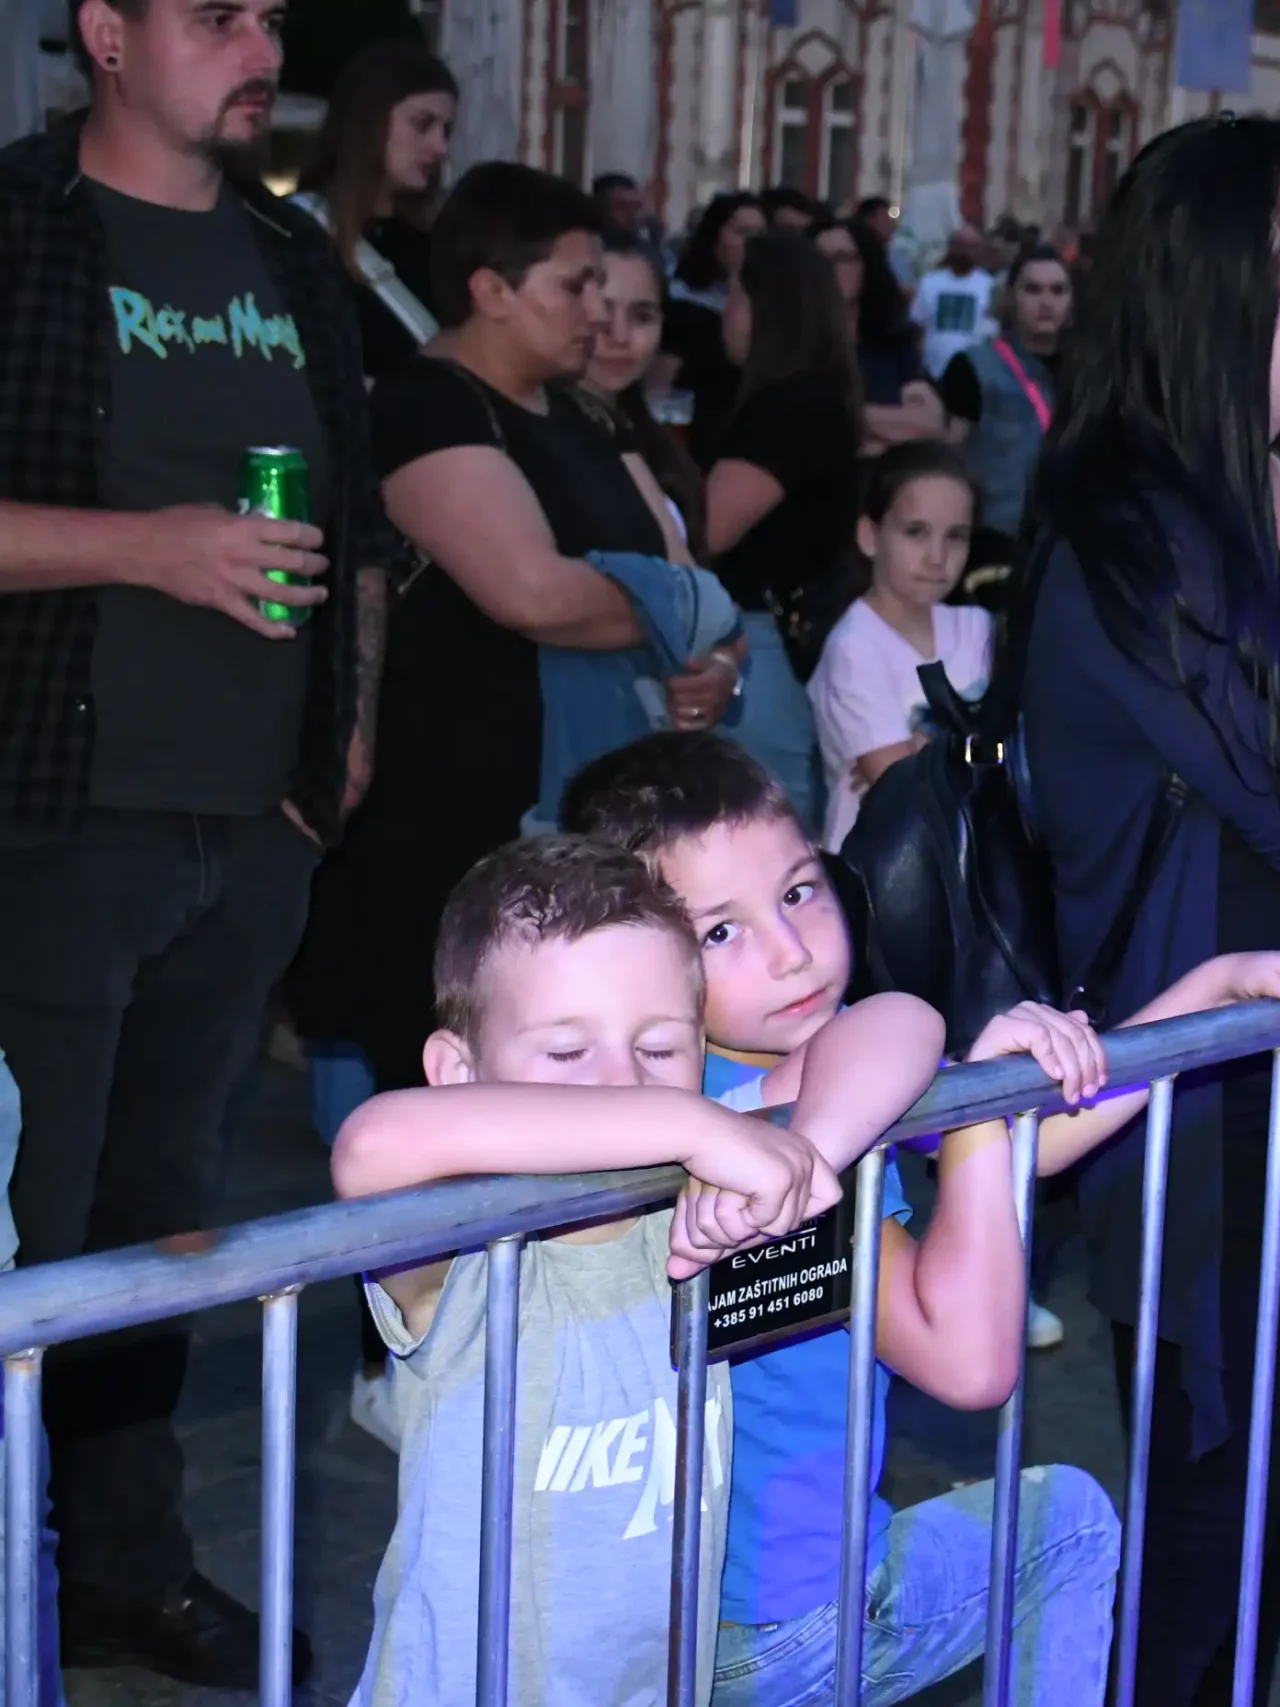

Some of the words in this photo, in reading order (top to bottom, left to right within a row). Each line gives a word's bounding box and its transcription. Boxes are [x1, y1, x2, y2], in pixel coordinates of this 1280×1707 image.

[732, 1234, 816, 1269] EVENTI
[738, 1272, 798, 1303] ZAŠTITNIH
[800, 1257, 848, 1284] OGRADA
[713, 1309, 746, 1328] +385
[749, 1304, 764, 1319] 91
[767, 1296, 789, 1313] 451
[793, 1286, 824, 1305] 6080
